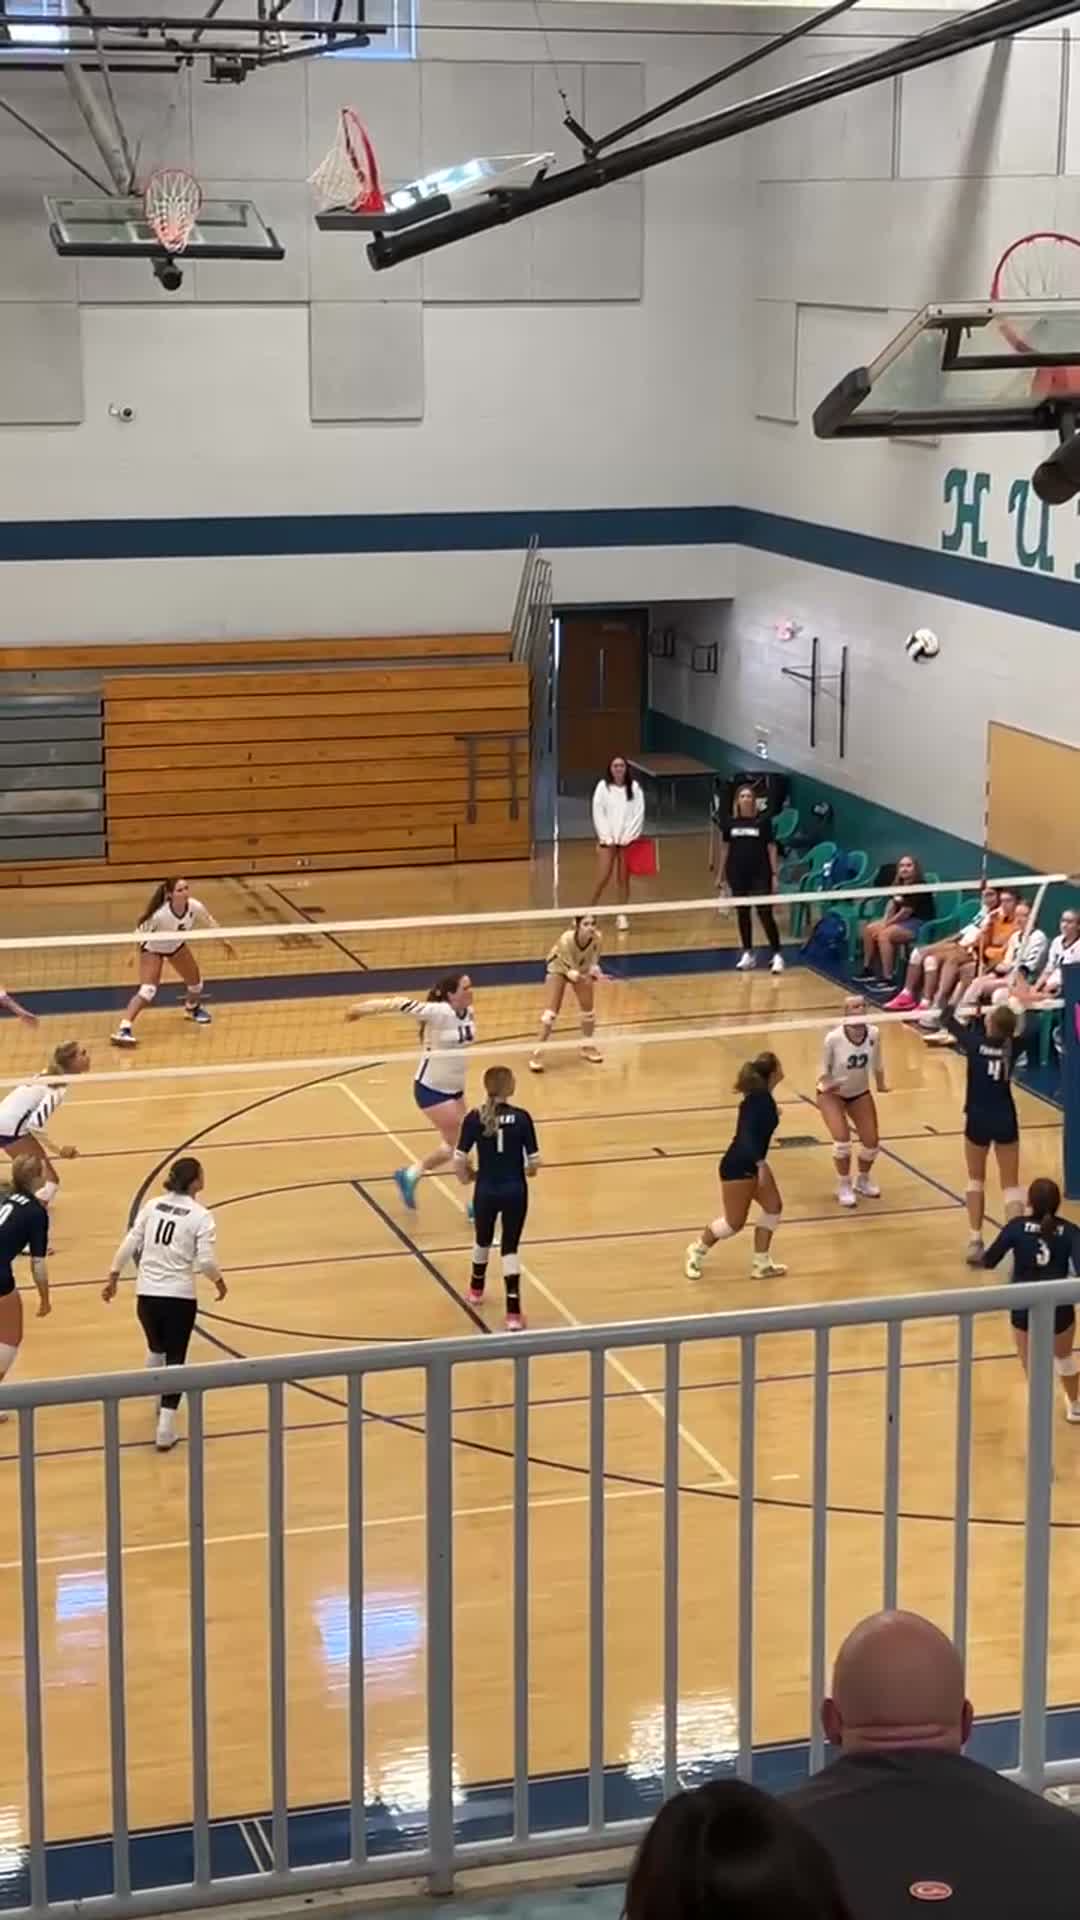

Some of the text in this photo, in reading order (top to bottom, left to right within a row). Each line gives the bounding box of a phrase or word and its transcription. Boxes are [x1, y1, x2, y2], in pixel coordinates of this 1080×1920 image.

[942, 468, 1080, 579] HU
[497, 1128, 504, 1153] 1
[155, 1218, 176, 1246] 10
[1035, 1237, 1050, 1265] 3
